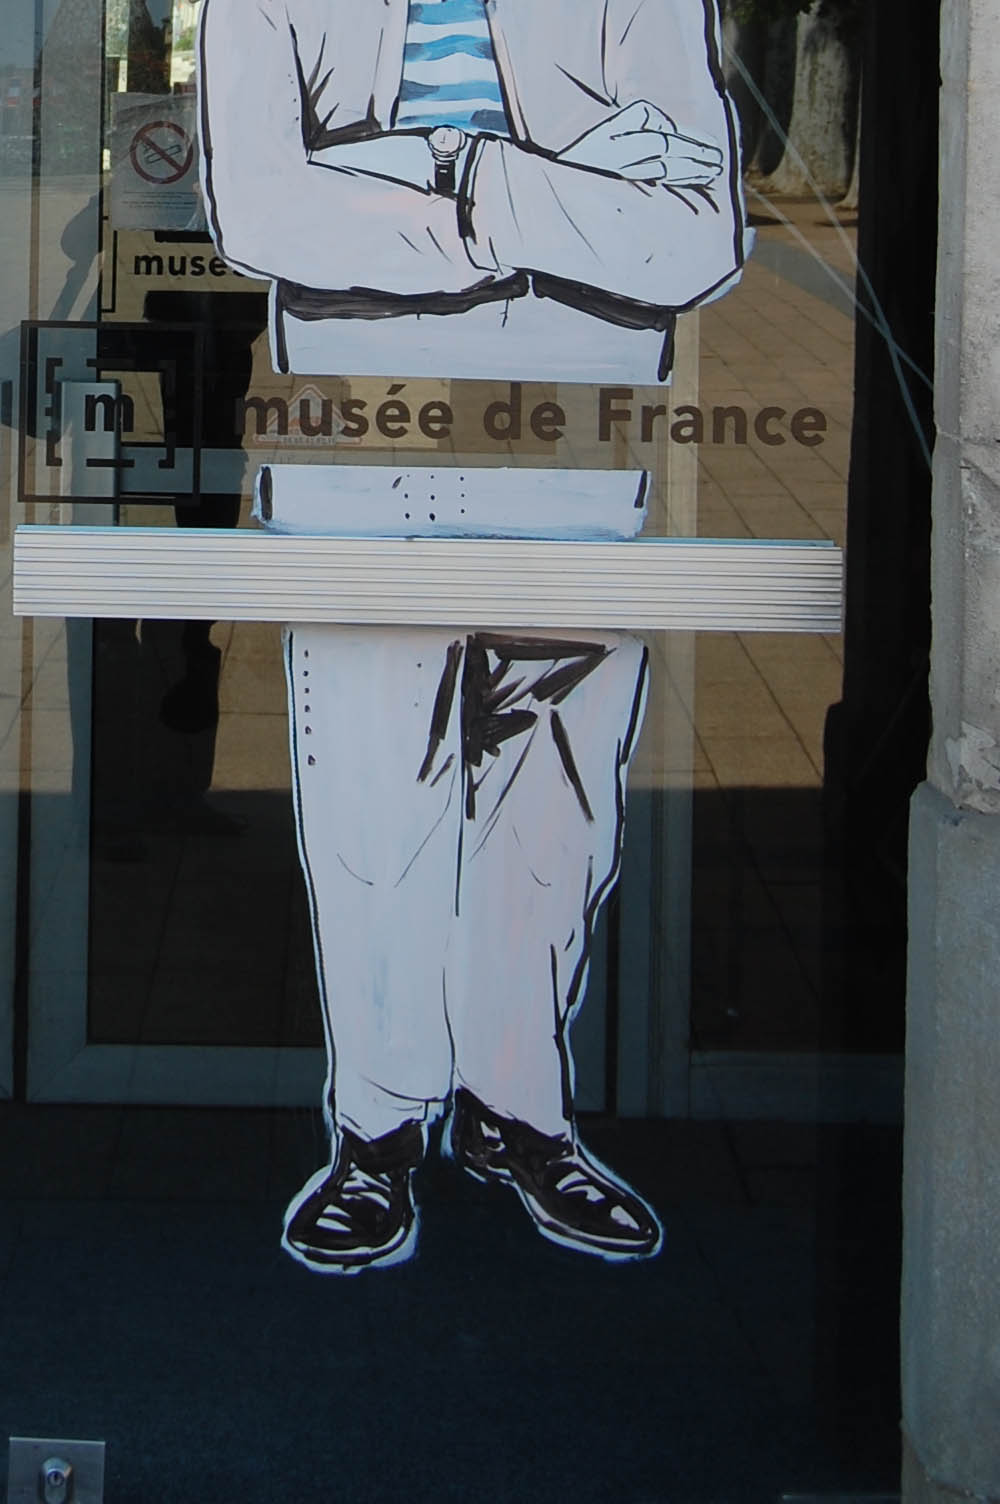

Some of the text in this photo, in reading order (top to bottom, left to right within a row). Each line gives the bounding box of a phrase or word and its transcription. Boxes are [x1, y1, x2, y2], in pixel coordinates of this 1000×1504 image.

[233, 381, 829, 447] musée de France
